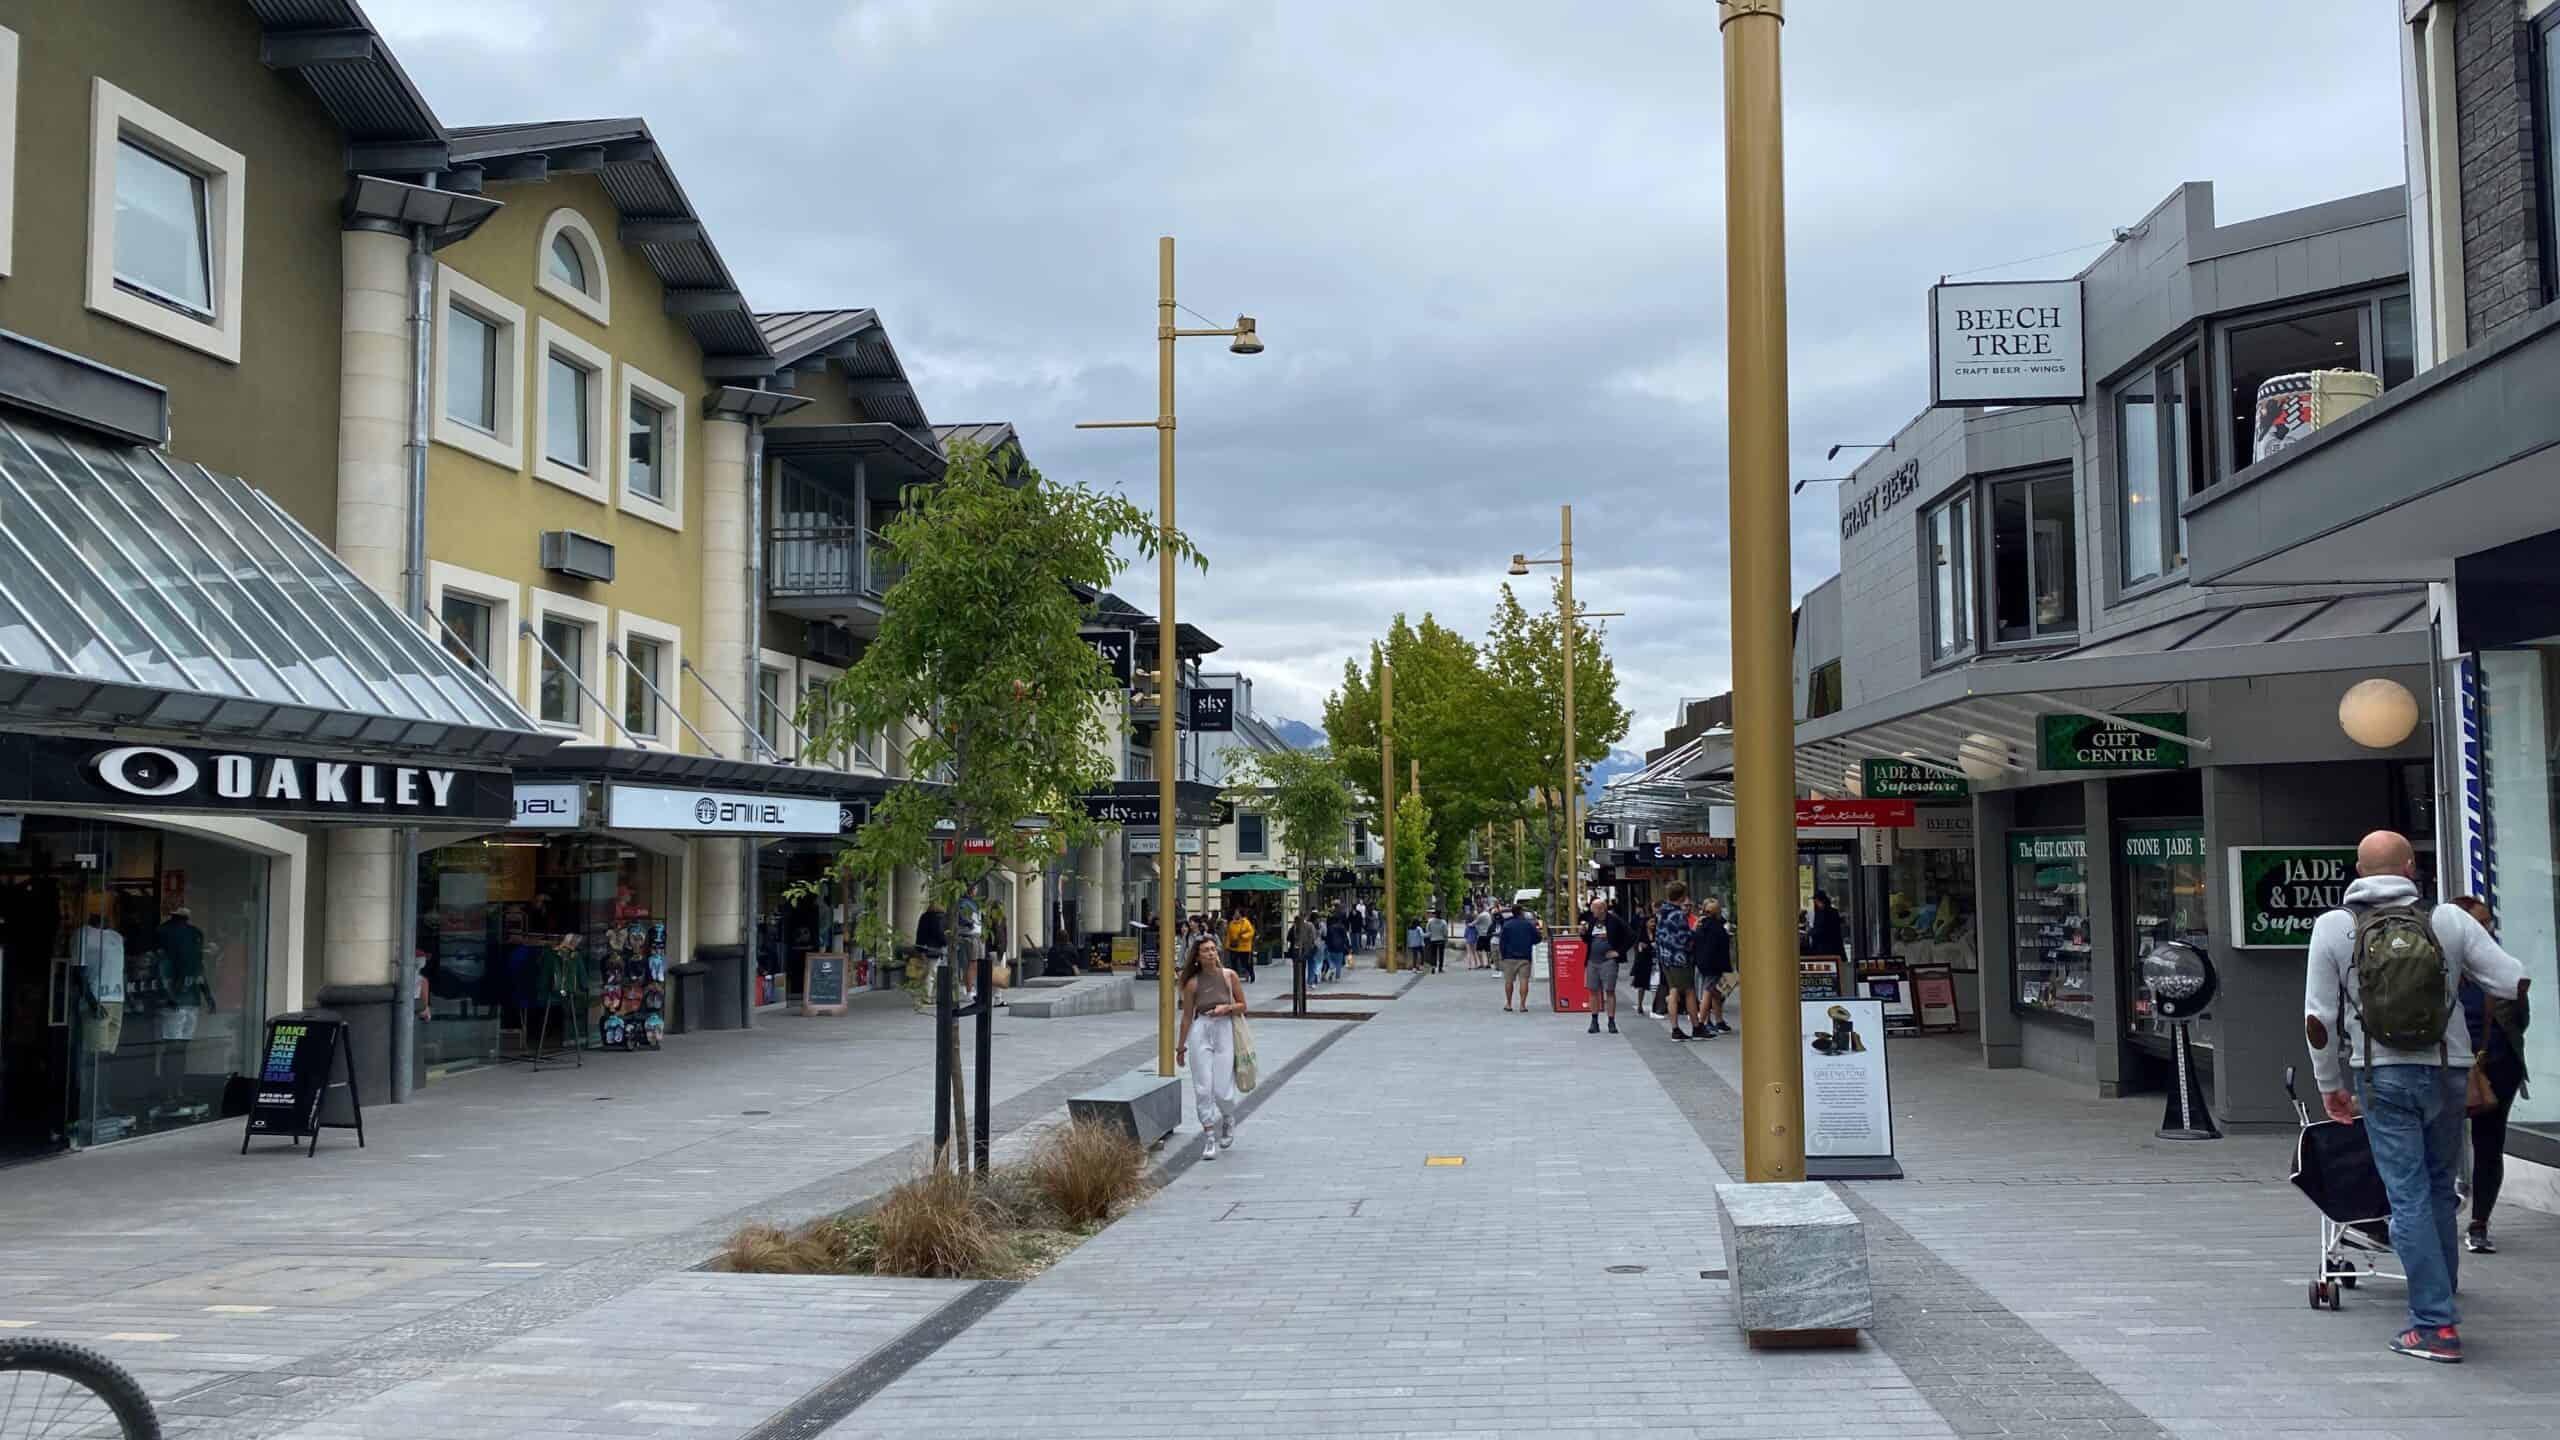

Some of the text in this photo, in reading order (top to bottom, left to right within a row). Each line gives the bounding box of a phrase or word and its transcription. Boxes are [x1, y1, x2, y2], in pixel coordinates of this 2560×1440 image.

[1956, 307, 2061, 331] BEECH
[1967, 334, 2052, 356] TREE
[1955, 366, 1990, 375] CRAFT
[1993, 366, 2021, 374] BEER
[2030, 364, 2066, 374] WINGS
[1842, 458, 1919, 541] CRAFT BEER
[2092, 732, 2141, 747] GIFT
[2076, 748, 2158, 763] CENTRE
[215, 754, 456, 807] OAKLEY
[1873, 765, 1908, 781] JADE
[1911, 766, 1921, 779] &
[1876, 779, 1958, 795] Superstore
[1589, 823, 1609, 835] UGG
[2019, 840, 2088, 857] The GIFT CENTR
[2126, 838, 2161, 856] STONE
[2165, 837, 2193, 860] JADE
[2283, 858, 2345, 886] JADE
[2269, 886, 2343, 908] & PAU
[2252, 912, 2318, 936] Supe
[275, 1026, 307, 1037] MAKE
[274, 1036, 298, 1045] SALE
